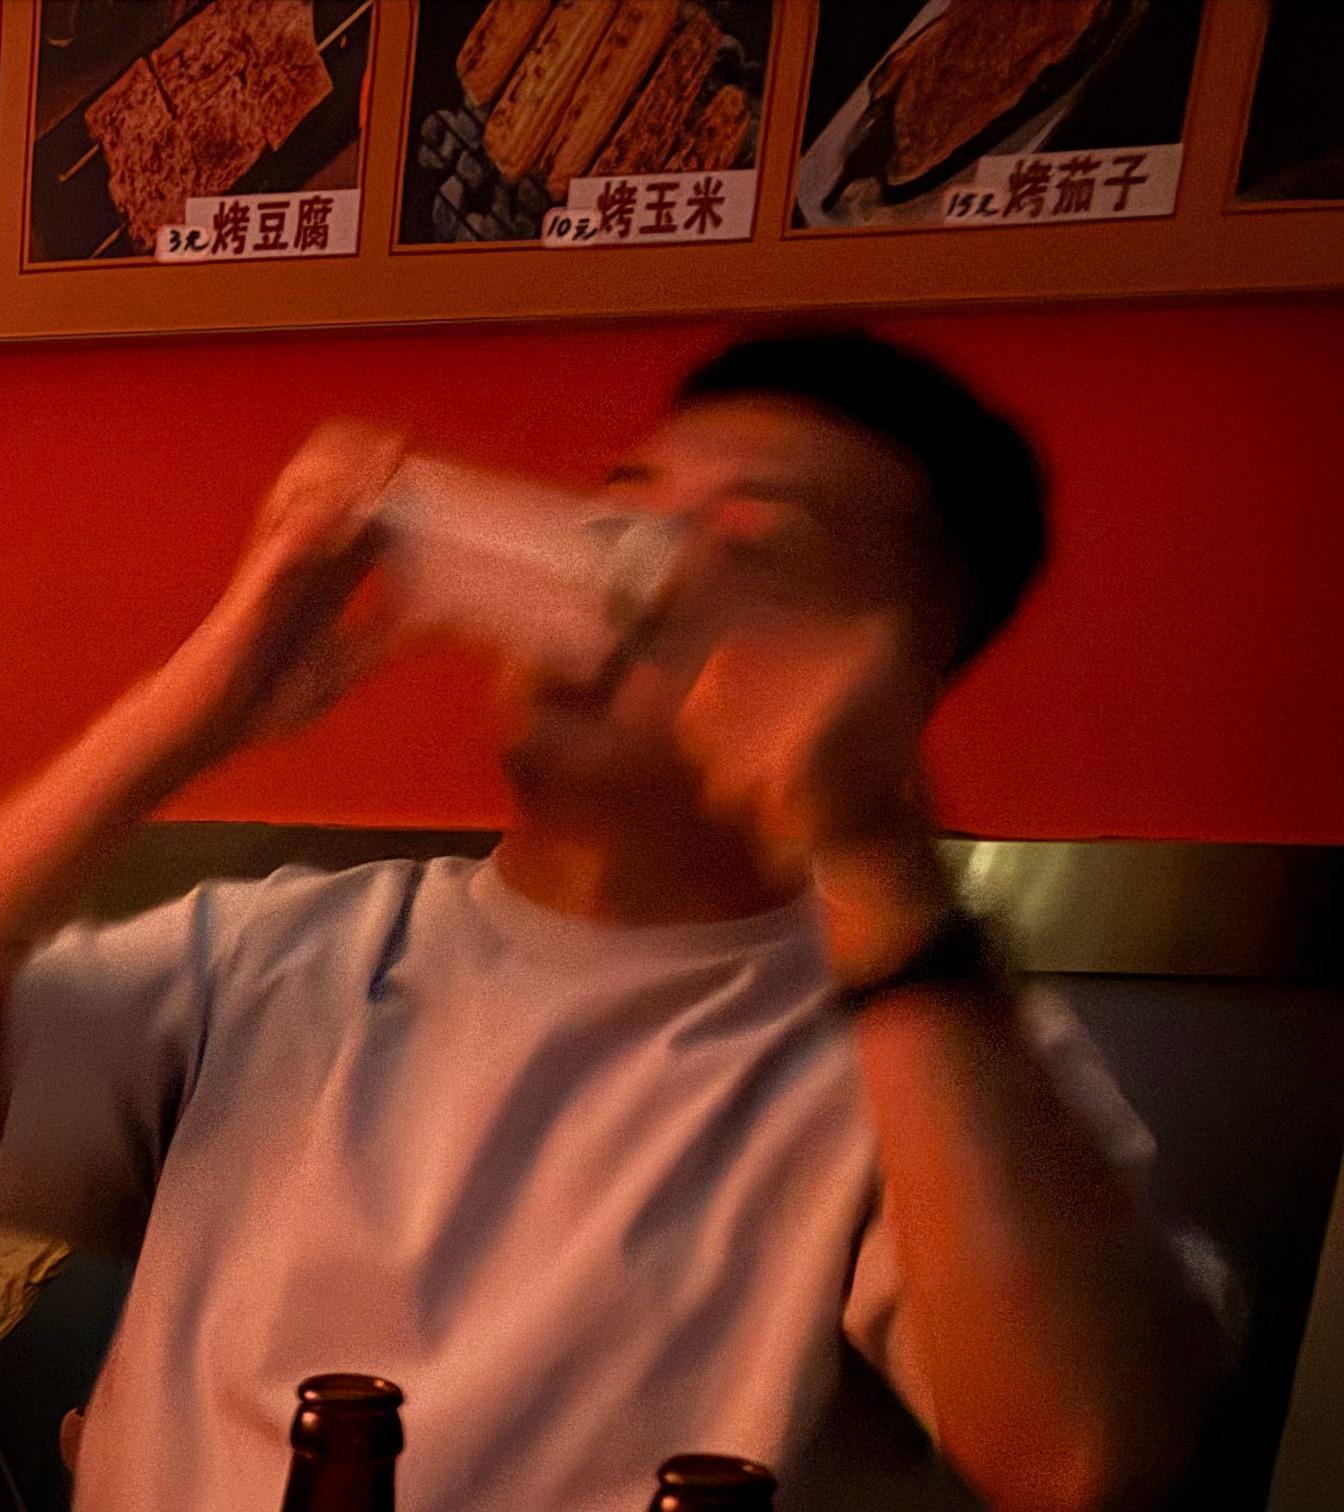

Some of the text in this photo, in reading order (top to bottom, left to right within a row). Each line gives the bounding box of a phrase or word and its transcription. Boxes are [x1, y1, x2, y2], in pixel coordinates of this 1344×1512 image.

[597, 176, 726, 239] 烤玉米
[1002, 153, 1150, 218] 烤茄子
[169, 229, 209, 252] 3元
[211, 195, 334, 255] 烤豆腐
[546, 215, 598, 241] 10元
